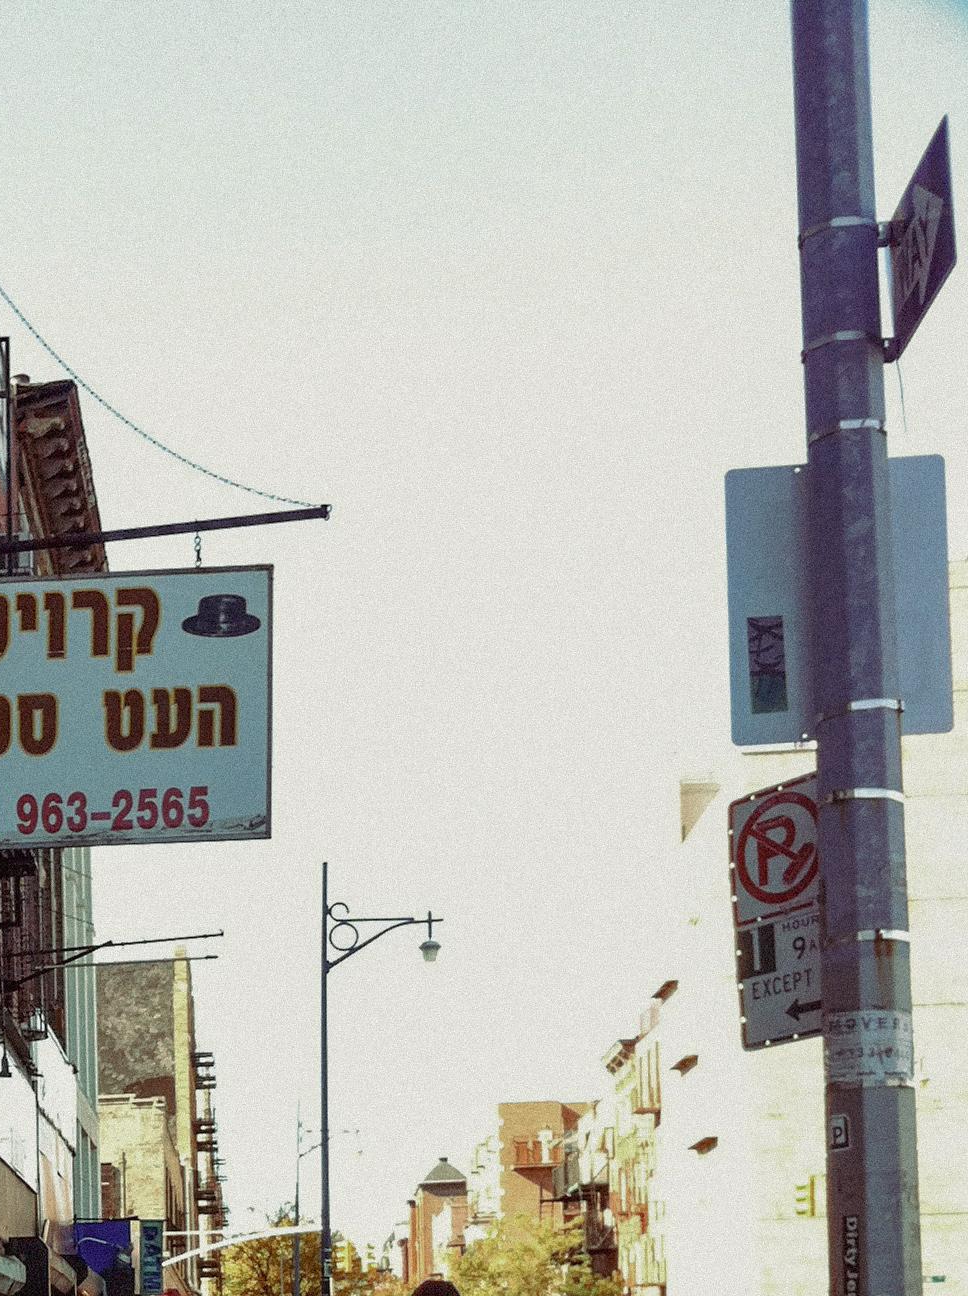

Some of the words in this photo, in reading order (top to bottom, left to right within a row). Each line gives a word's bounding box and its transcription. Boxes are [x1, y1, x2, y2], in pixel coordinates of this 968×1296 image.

[103, 683, 239, 754] העט
[15, 785, 211, 836] 963-2565
[751, 967, 813, 1000] EXCEPT
